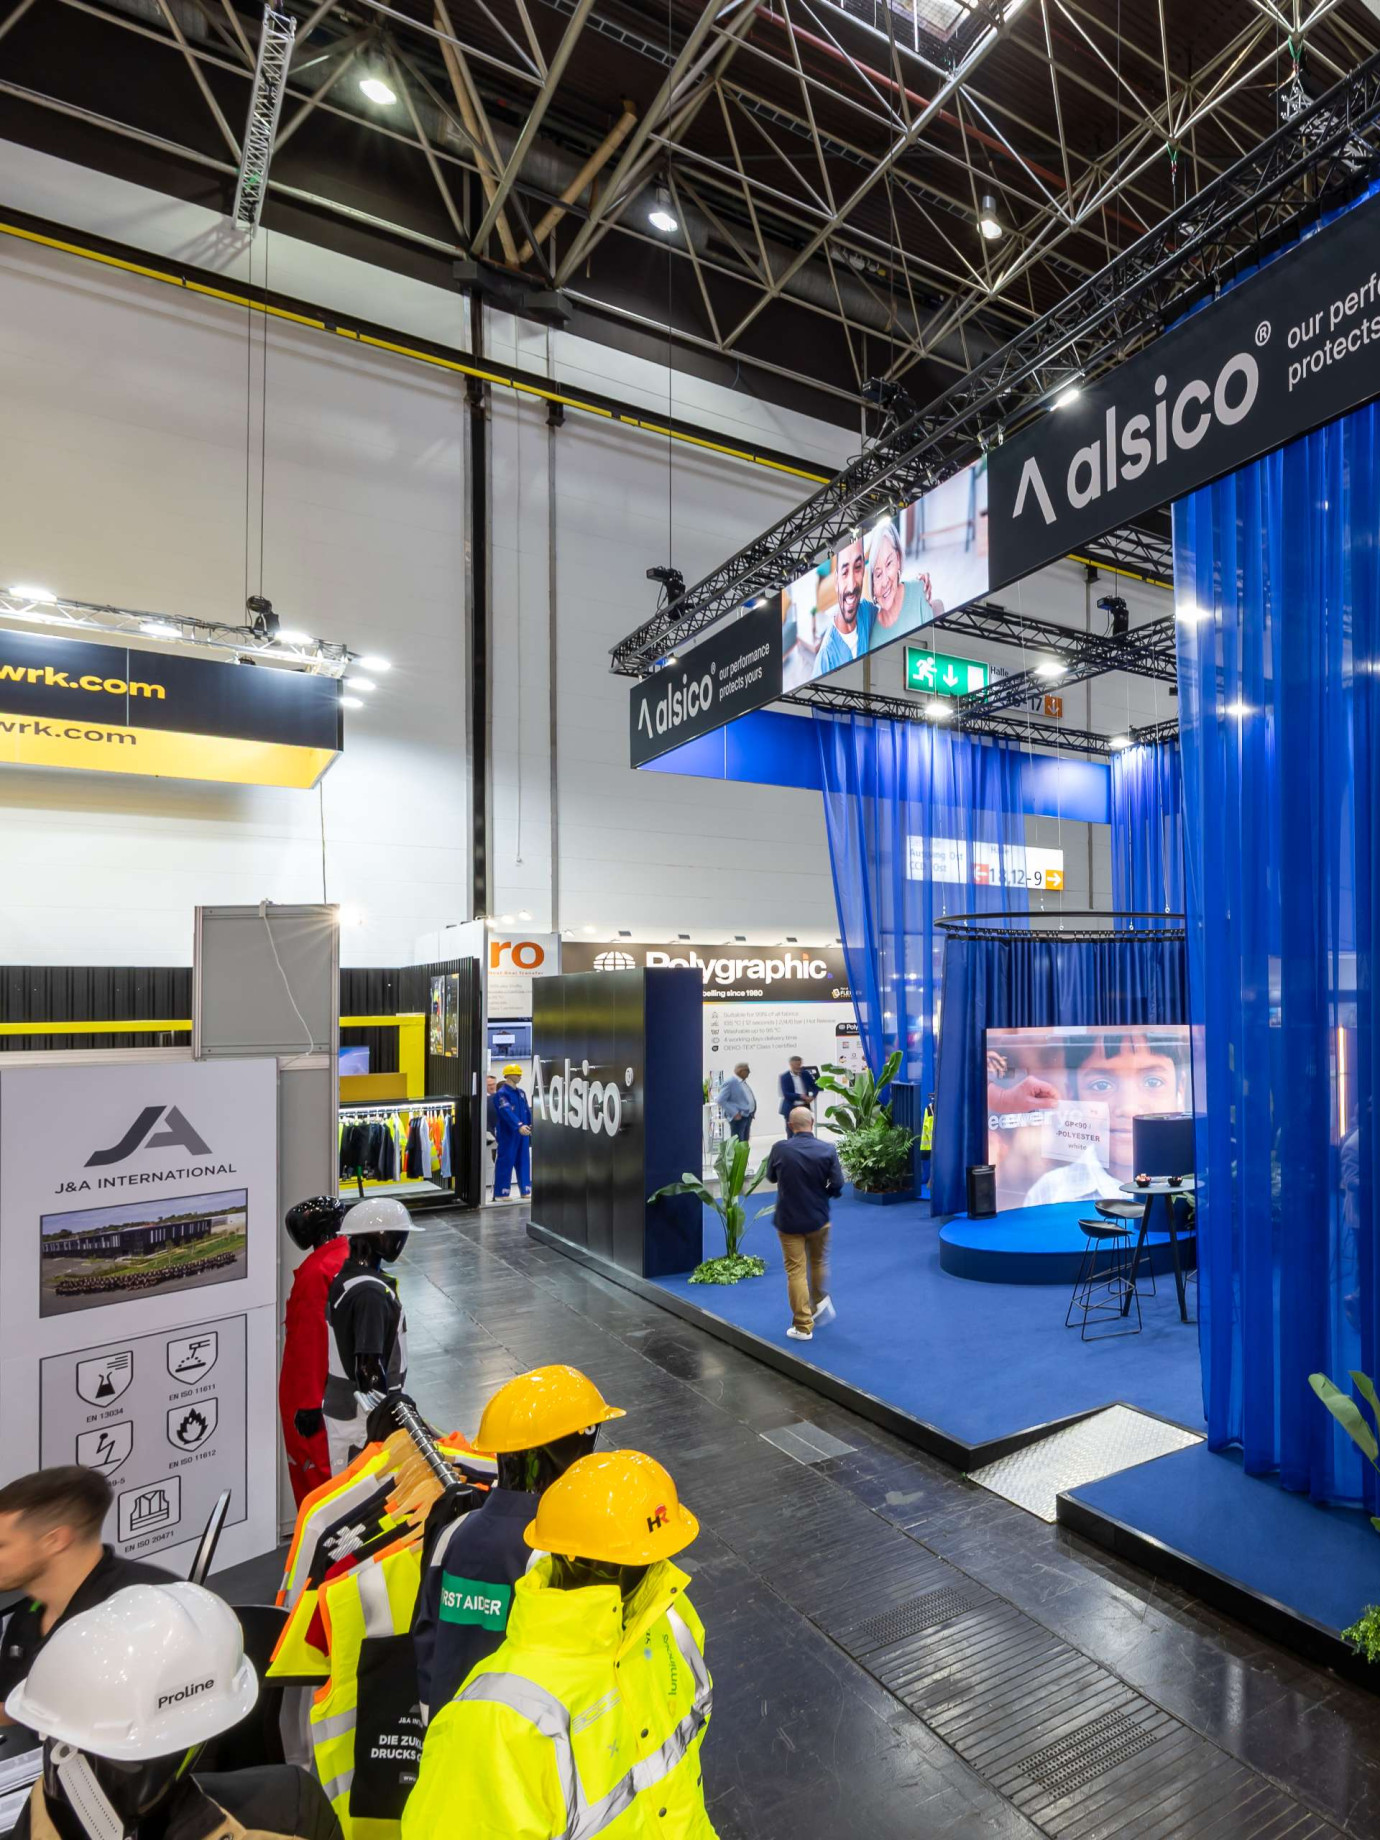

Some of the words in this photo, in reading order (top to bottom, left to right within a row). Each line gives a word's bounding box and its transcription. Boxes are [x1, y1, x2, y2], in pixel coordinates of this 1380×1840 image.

[1286, 310, 1324, 350] our
[729, 642, 770, 677] performance
[990, 665, 1009, 678] Halle
[719, 676, 744, 702] protects
[490, 941, 545, 970] ro
[727, 989, 746, 998] since
[55, 1180, 91, 1195] J&A
[98, 1163, 237, 1189] INTERNATIONAL
[169, 1393, 180, 1401] EN
[181, 1389, 193, 1398] ISO
[86, 1414, 98, 1423] EN
[100, 1408, 124, 1420] 13034
[169, 1461, 179, 1470] EN
[180, 1457, 193, 1466] ISO
[125, 1545, 135, 1553] EN
[137, 1539, 150, 1549] ISO
[152, 1531, 175, 1545] 20471
[463, 1595, 502, 1616] AIDER
[379, 1734, 399, 1746] DIE
